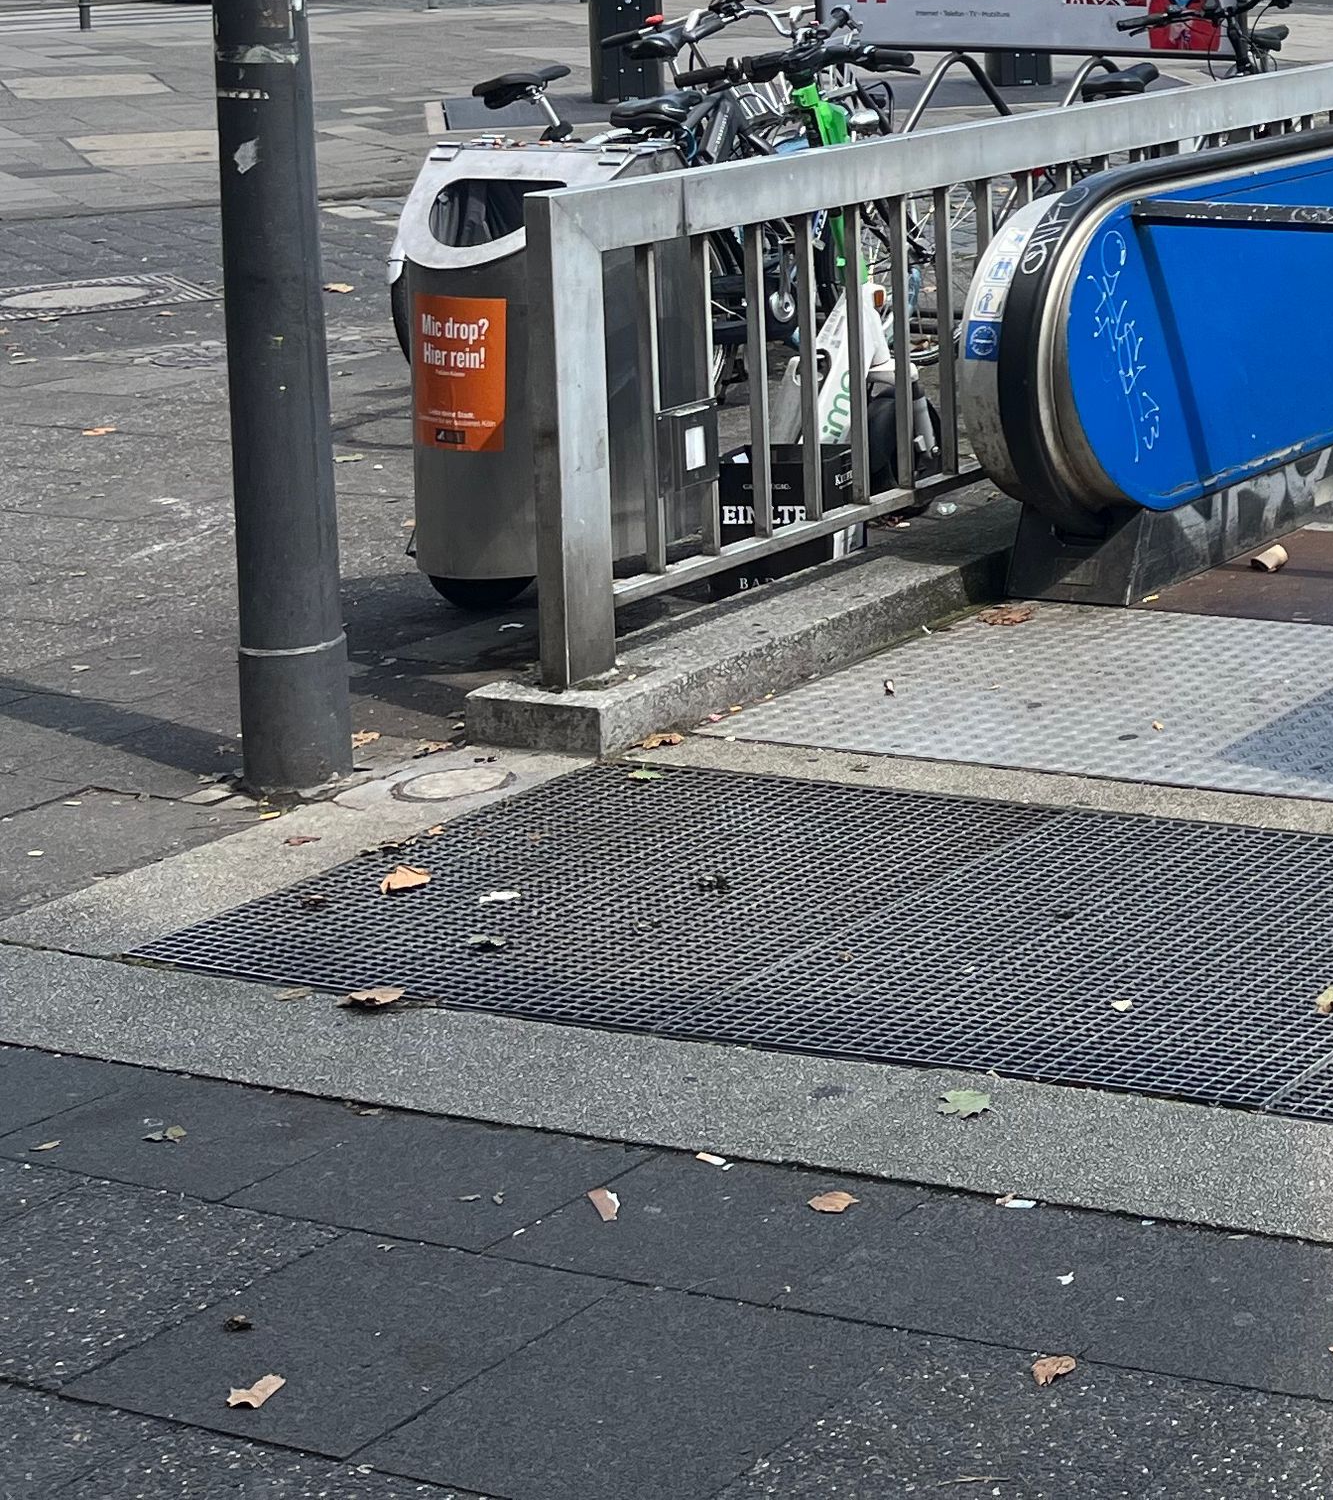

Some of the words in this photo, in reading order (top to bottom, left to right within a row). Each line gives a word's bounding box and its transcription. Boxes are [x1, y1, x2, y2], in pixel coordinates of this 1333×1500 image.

[421, 313, 442, 338] Mic
[445, 316, 490, 346] drop?
[423, 342, 447, 367] Hier
[450, 346, 485, 369] rein!
